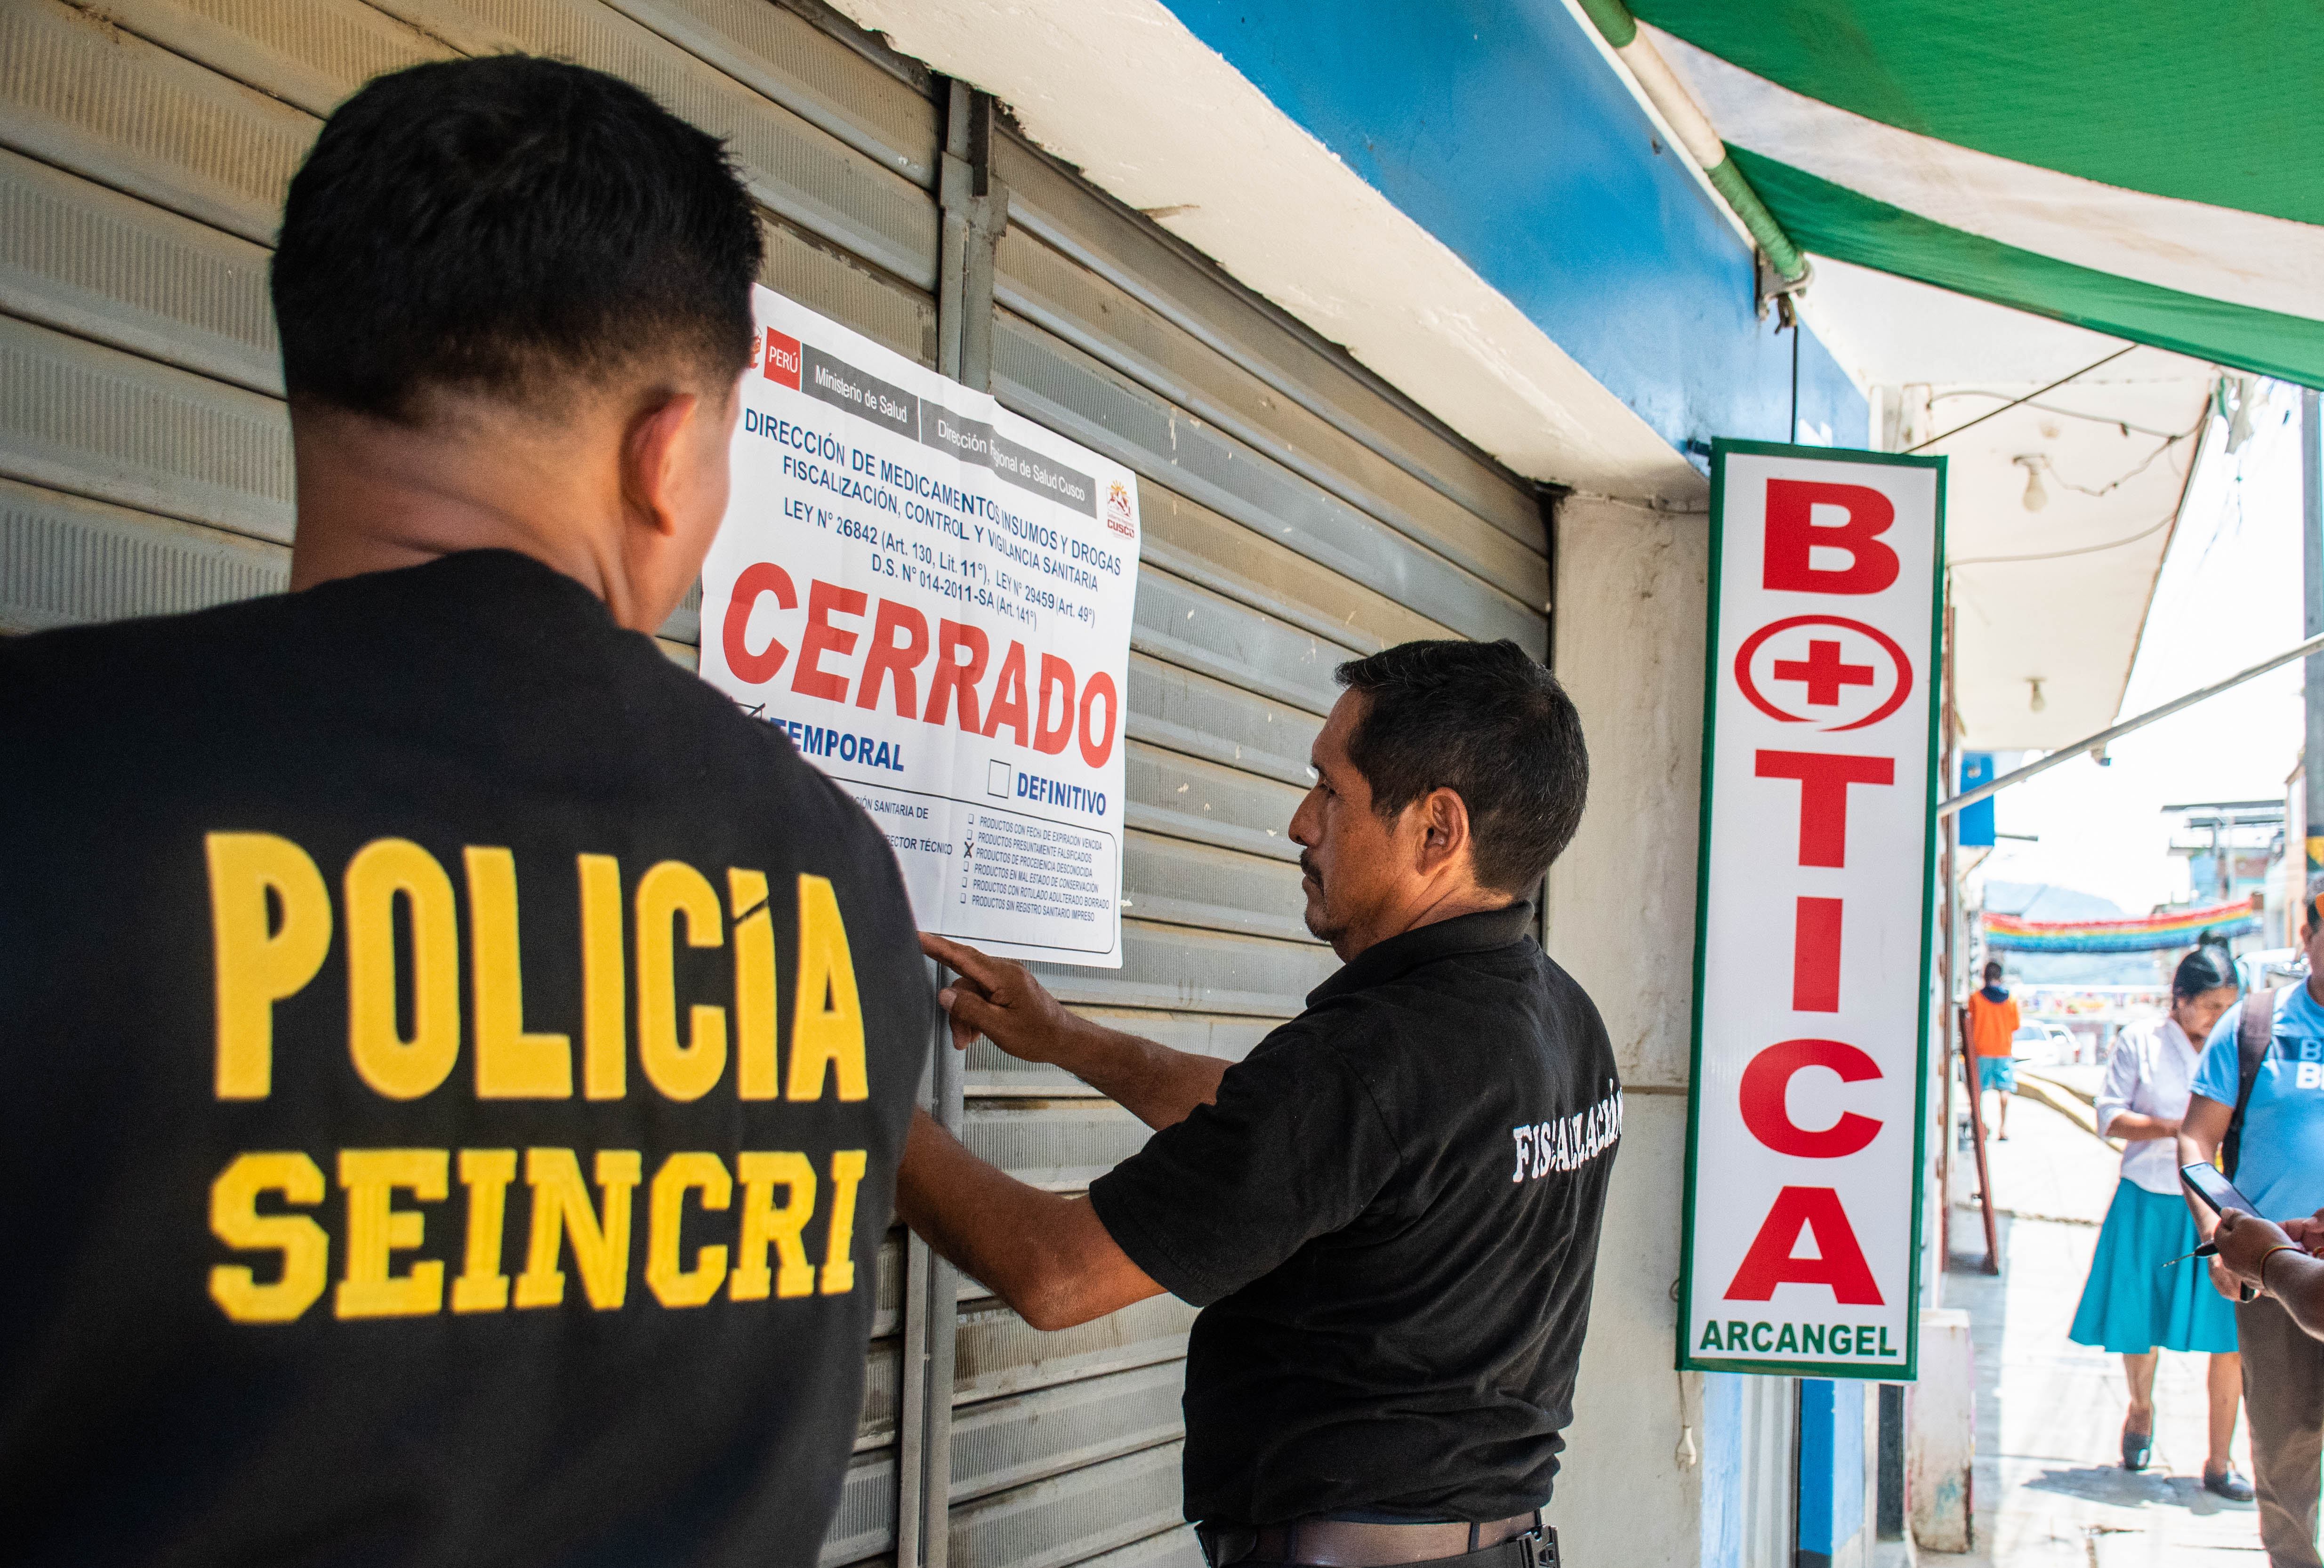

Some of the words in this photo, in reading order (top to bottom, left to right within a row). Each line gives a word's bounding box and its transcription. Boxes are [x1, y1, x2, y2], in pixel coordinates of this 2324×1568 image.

[769, 346, 798, 373] PERÚ
[816, 365, 862, 403] Ministerio
[865, 389, 877, 410] de
[880, 395, 907, 423] Salud
[938, 419, 987, 454] Dirección
[1020, 459, 1031, 478] de
[1033, 465, 1057, 490] Salud
[1059, 477, 1085, 502] Cusco
[745, 408, 845, 466] DIRECCIÓN
[852, 449, 876, 477] DE
[881, 459, 999, 525] MEDICAMENTOS
[1002, 509, 1058, 550] INSUMOS
[1061, 535, 1069, 555] Y
[1071, 539, 1121, 576] DROGAS
[784, 455, 901, 518] FISCALIZACIÓN,
[905, 501, 969, 540] CONTROL
[974, 525, 984, 543] Y
[988, 528, 1040, 571] VIGILANCIA
[1043, 556, 1098, 592] SANITARIA
[1107, 518, 1134, 538] CUSCO
[784, 497, 813, 523] LEY
[836, 516, 877, 545] 26842
[882, 531, 908, 556] (Art.
[912, 542, 935, 569] 130,
[940, 552, 957, 573] Lit.
[997, 570, 1012, 592] LEY
[1025, 585, 1054, 609] 29459
[1056, 596, 1075, 619] (Art.
[872, 554, 898, 579] D.S.
[920, 570, 994, 609] 014-2011-SA
[997, 594, 1014, 619] (Art.
[722, 562, 1118, 768] CERRADO
[874, 800, 914, 817] SANITARIA
[917, 807, 929, 819] DE
[1017, 771, 1107, 816] DEFINITIVO
[885, 835, 917, 850] RECTOR
[920, 837, 953, 855] TÉCNICO
[978, 831, 1012, 848] PRODUCTOS
[1013, 838, 1057, 857] PRESUNTAMENTE
[1058, 847, 1092, 863] FALSIFICADOS
[980, 816, 1013, 833] PRODUCTOS
[1014, 823, 1026, 836] CON
[1043, 830, 1052, 841] DE
[1053, 831, 1081, 846] EXPIRACIÓN
[1082, 837, 1102, 851] VENCIDA
[974, 863, 1009, 879] PRODUCTOS
[1010, 869, 1017, 880] EN
[1018, 870, 1029, 883] MAL
[1029, 873, 1050, 886] ESTADO
[1051, 876, 1059, 887] DE
[1059, 877, 1099, 893] CONSERVACIÓN
[976, 847, 1011, 864] PRODUCTOS
[1012, 853, 1019, 865] DE
[1020, 855, 1055, 871] PROCEDENCIA
[1056, 862, 1093, 877] DESCONOCIDA
[972, 894, 1005, 909] PRODUCTOS
[1006, 900, 1015, 911] SIN
[1016, 901, 1042, 915] REGISTRO
[1043, 905, 1070, 918] SANITARIO
[1071, 909, 1095, 922] IMPRESO
[973, 879, 1007, 894] PRODUCTOS
[1008, 885, 1020, 896] CON
[1020, 886, 1048, 901] ROTULADO
[1048, 891, 1083, 906] ADULTERADO
[1084, 896, 1110, 909] BORRADO
[205, 830, 869, 1102] POLICÍA
[207, 1148, 868, 1323] SEINCRI
[1699, 1320, 1898, 1357] ARCANGEL
